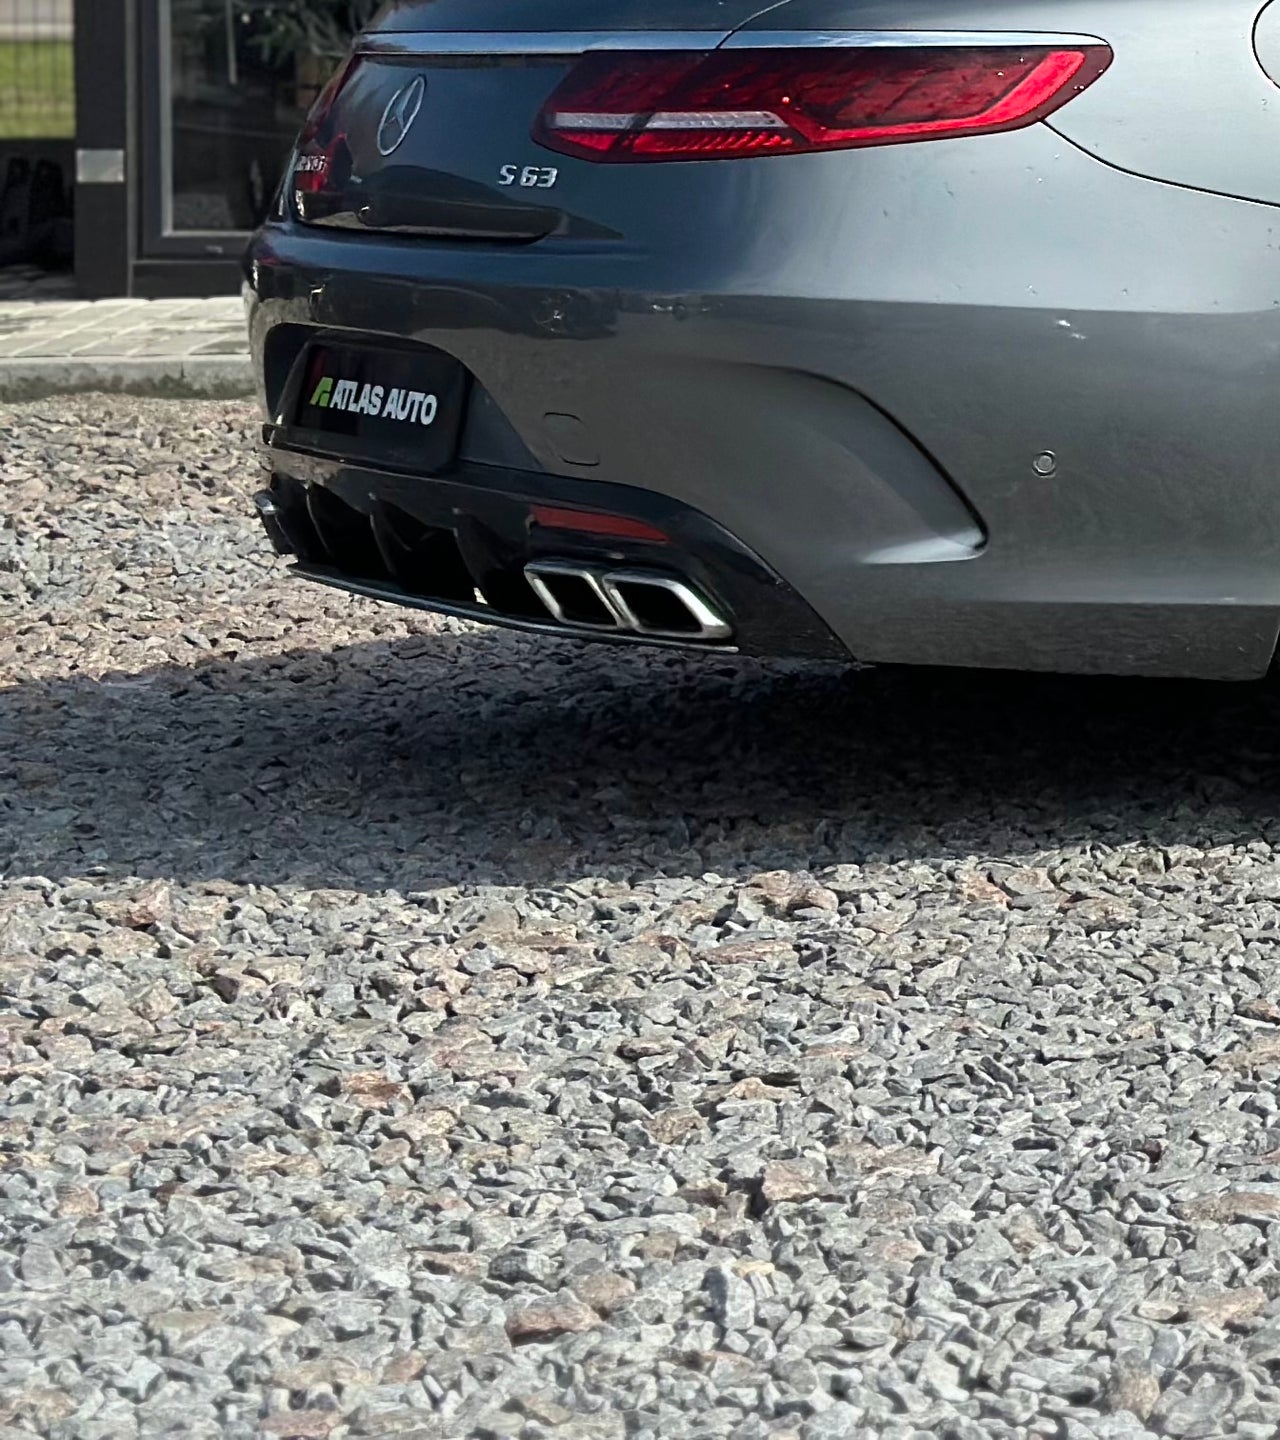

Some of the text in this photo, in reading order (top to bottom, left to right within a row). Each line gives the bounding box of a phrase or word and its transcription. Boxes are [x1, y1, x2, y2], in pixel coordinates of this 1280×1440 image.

[498, 164, 558, 188] S 63
[329, 379, 438, 426] ATLAS AUTO
